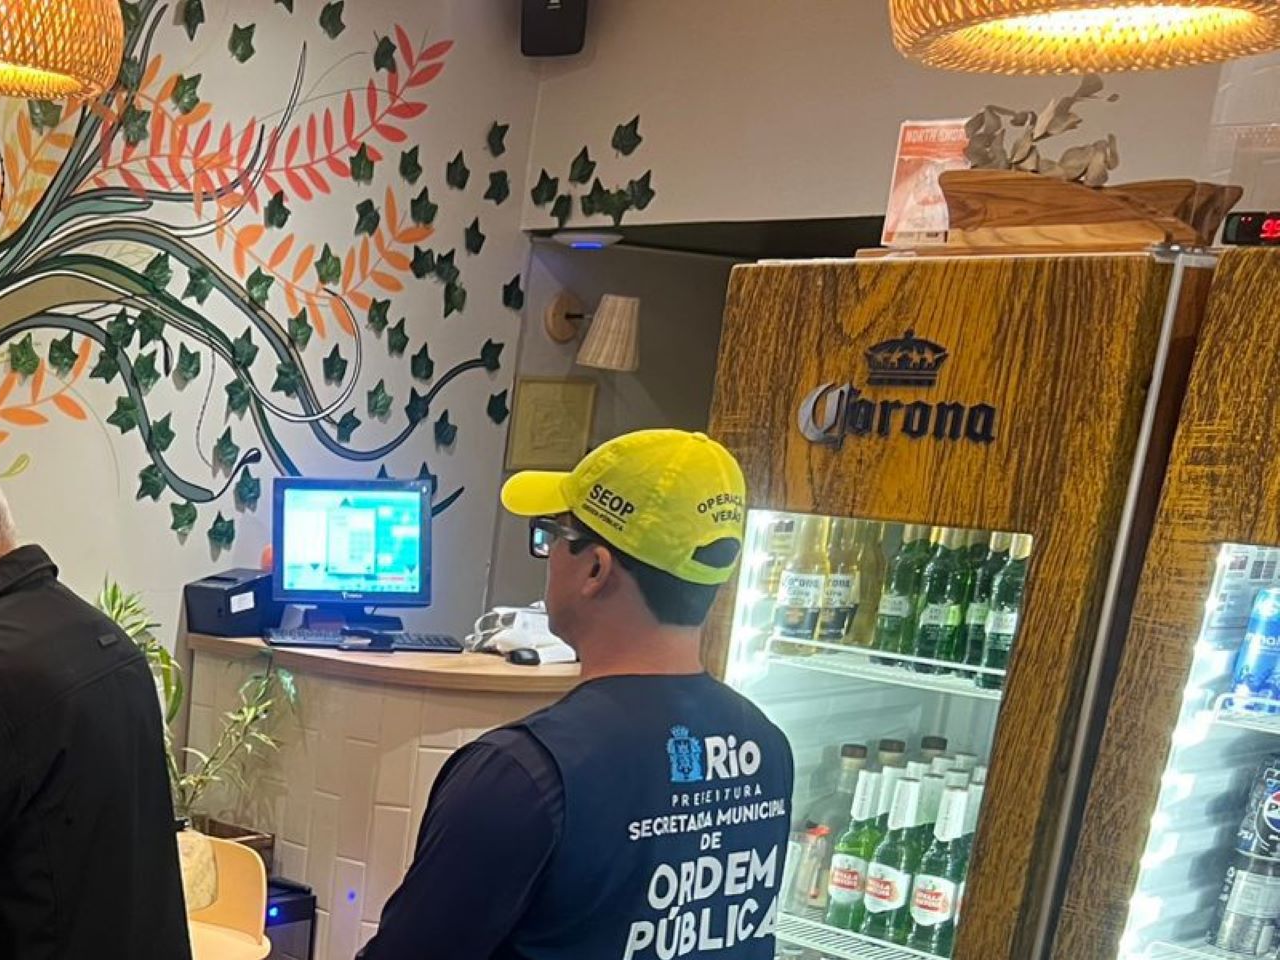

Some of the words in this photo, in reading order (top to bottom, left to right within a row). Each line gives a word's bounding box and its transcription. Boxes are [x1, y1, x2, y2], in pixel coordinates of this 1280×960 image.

[798, 381, 996, 449] Corona
[589, 484, 634, 516] SEOP
[628, 815, 713, 840] SECRETAA
[699, 831, 722, 851] DE
[647, 844, 778, 910] ORDEM
